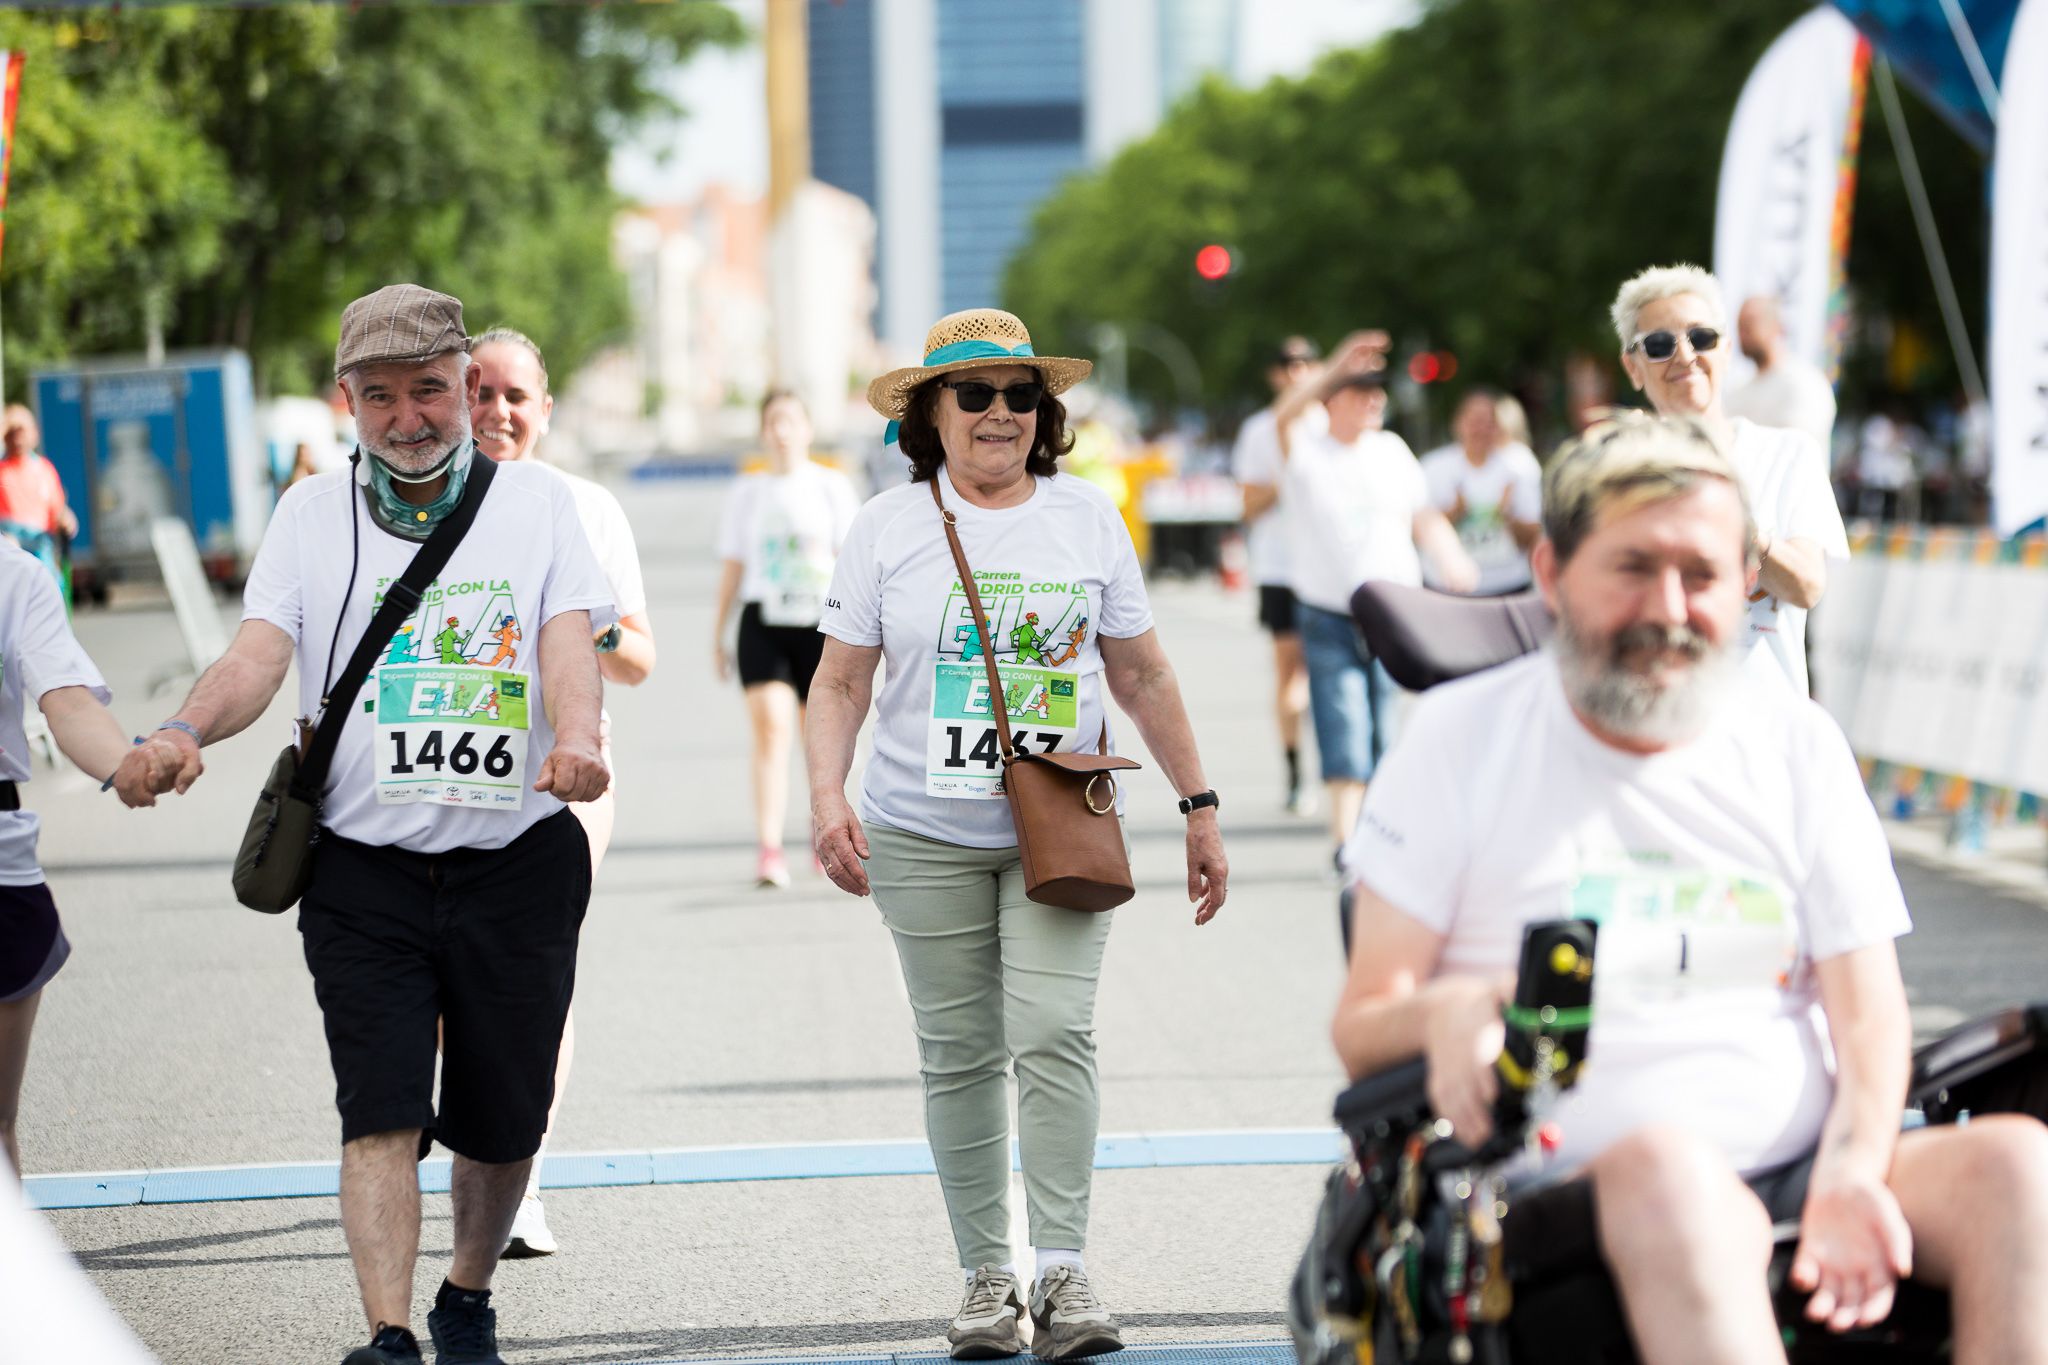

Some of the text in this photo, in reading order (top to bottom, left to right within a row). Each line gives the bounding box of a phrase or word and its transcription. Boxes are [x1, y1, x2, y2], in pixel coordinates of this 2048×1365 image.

[973, 570, 1021, 580] Carrera
[447, 581, 484, 597] CON
[489, 580, 511, 592] LA
[1029, 583, 1067, 593] CON
[1071, 583, 1087, 595] LA
[415, 672, 456, 680] MADRID
[459, 672, 480, 681] CON
[1012, 671, 1032, 680] CON
[407, 680, 500, 720] ELA
[390, 730, 514, 778] 1466
[1679, 933, 1688, 973] 1
